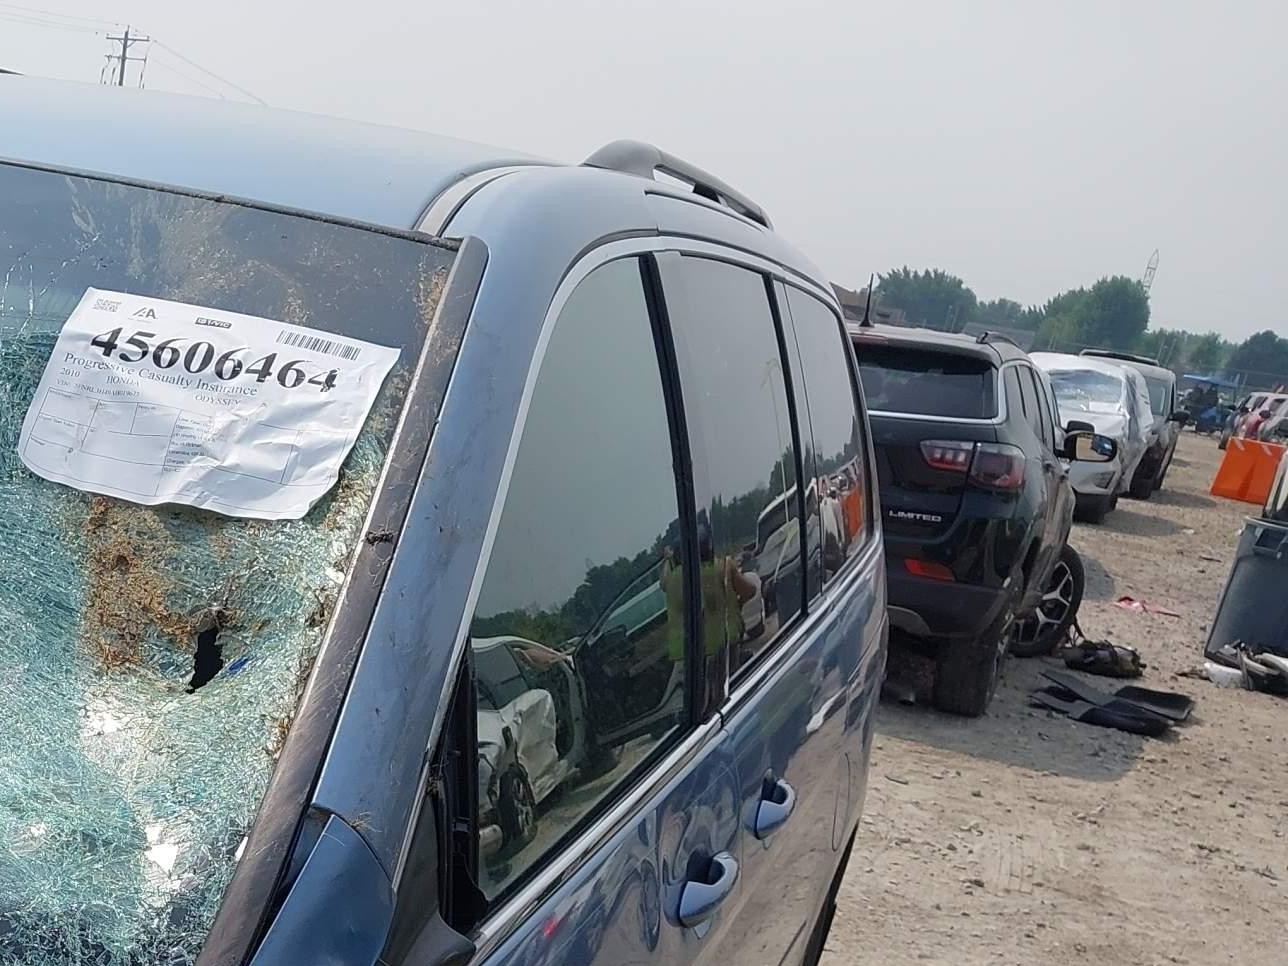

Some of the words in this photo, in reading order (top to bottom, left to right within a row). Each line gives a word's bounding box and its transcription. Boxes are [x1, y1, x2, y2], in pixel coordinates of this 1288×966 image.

[64, 352, 135, 375] Progressive
[138, 368, 192, 389] Casualty
[196, 378, 258, 396] Insurance
[91, 327, 339, 393] 45606464
[59, 367, 81, 378] 2010
[106, 375, 140, 387] HONDA
[195, 394, 241, 406] ODYSSEY
[889, 510, 942, 522] LIMITED
